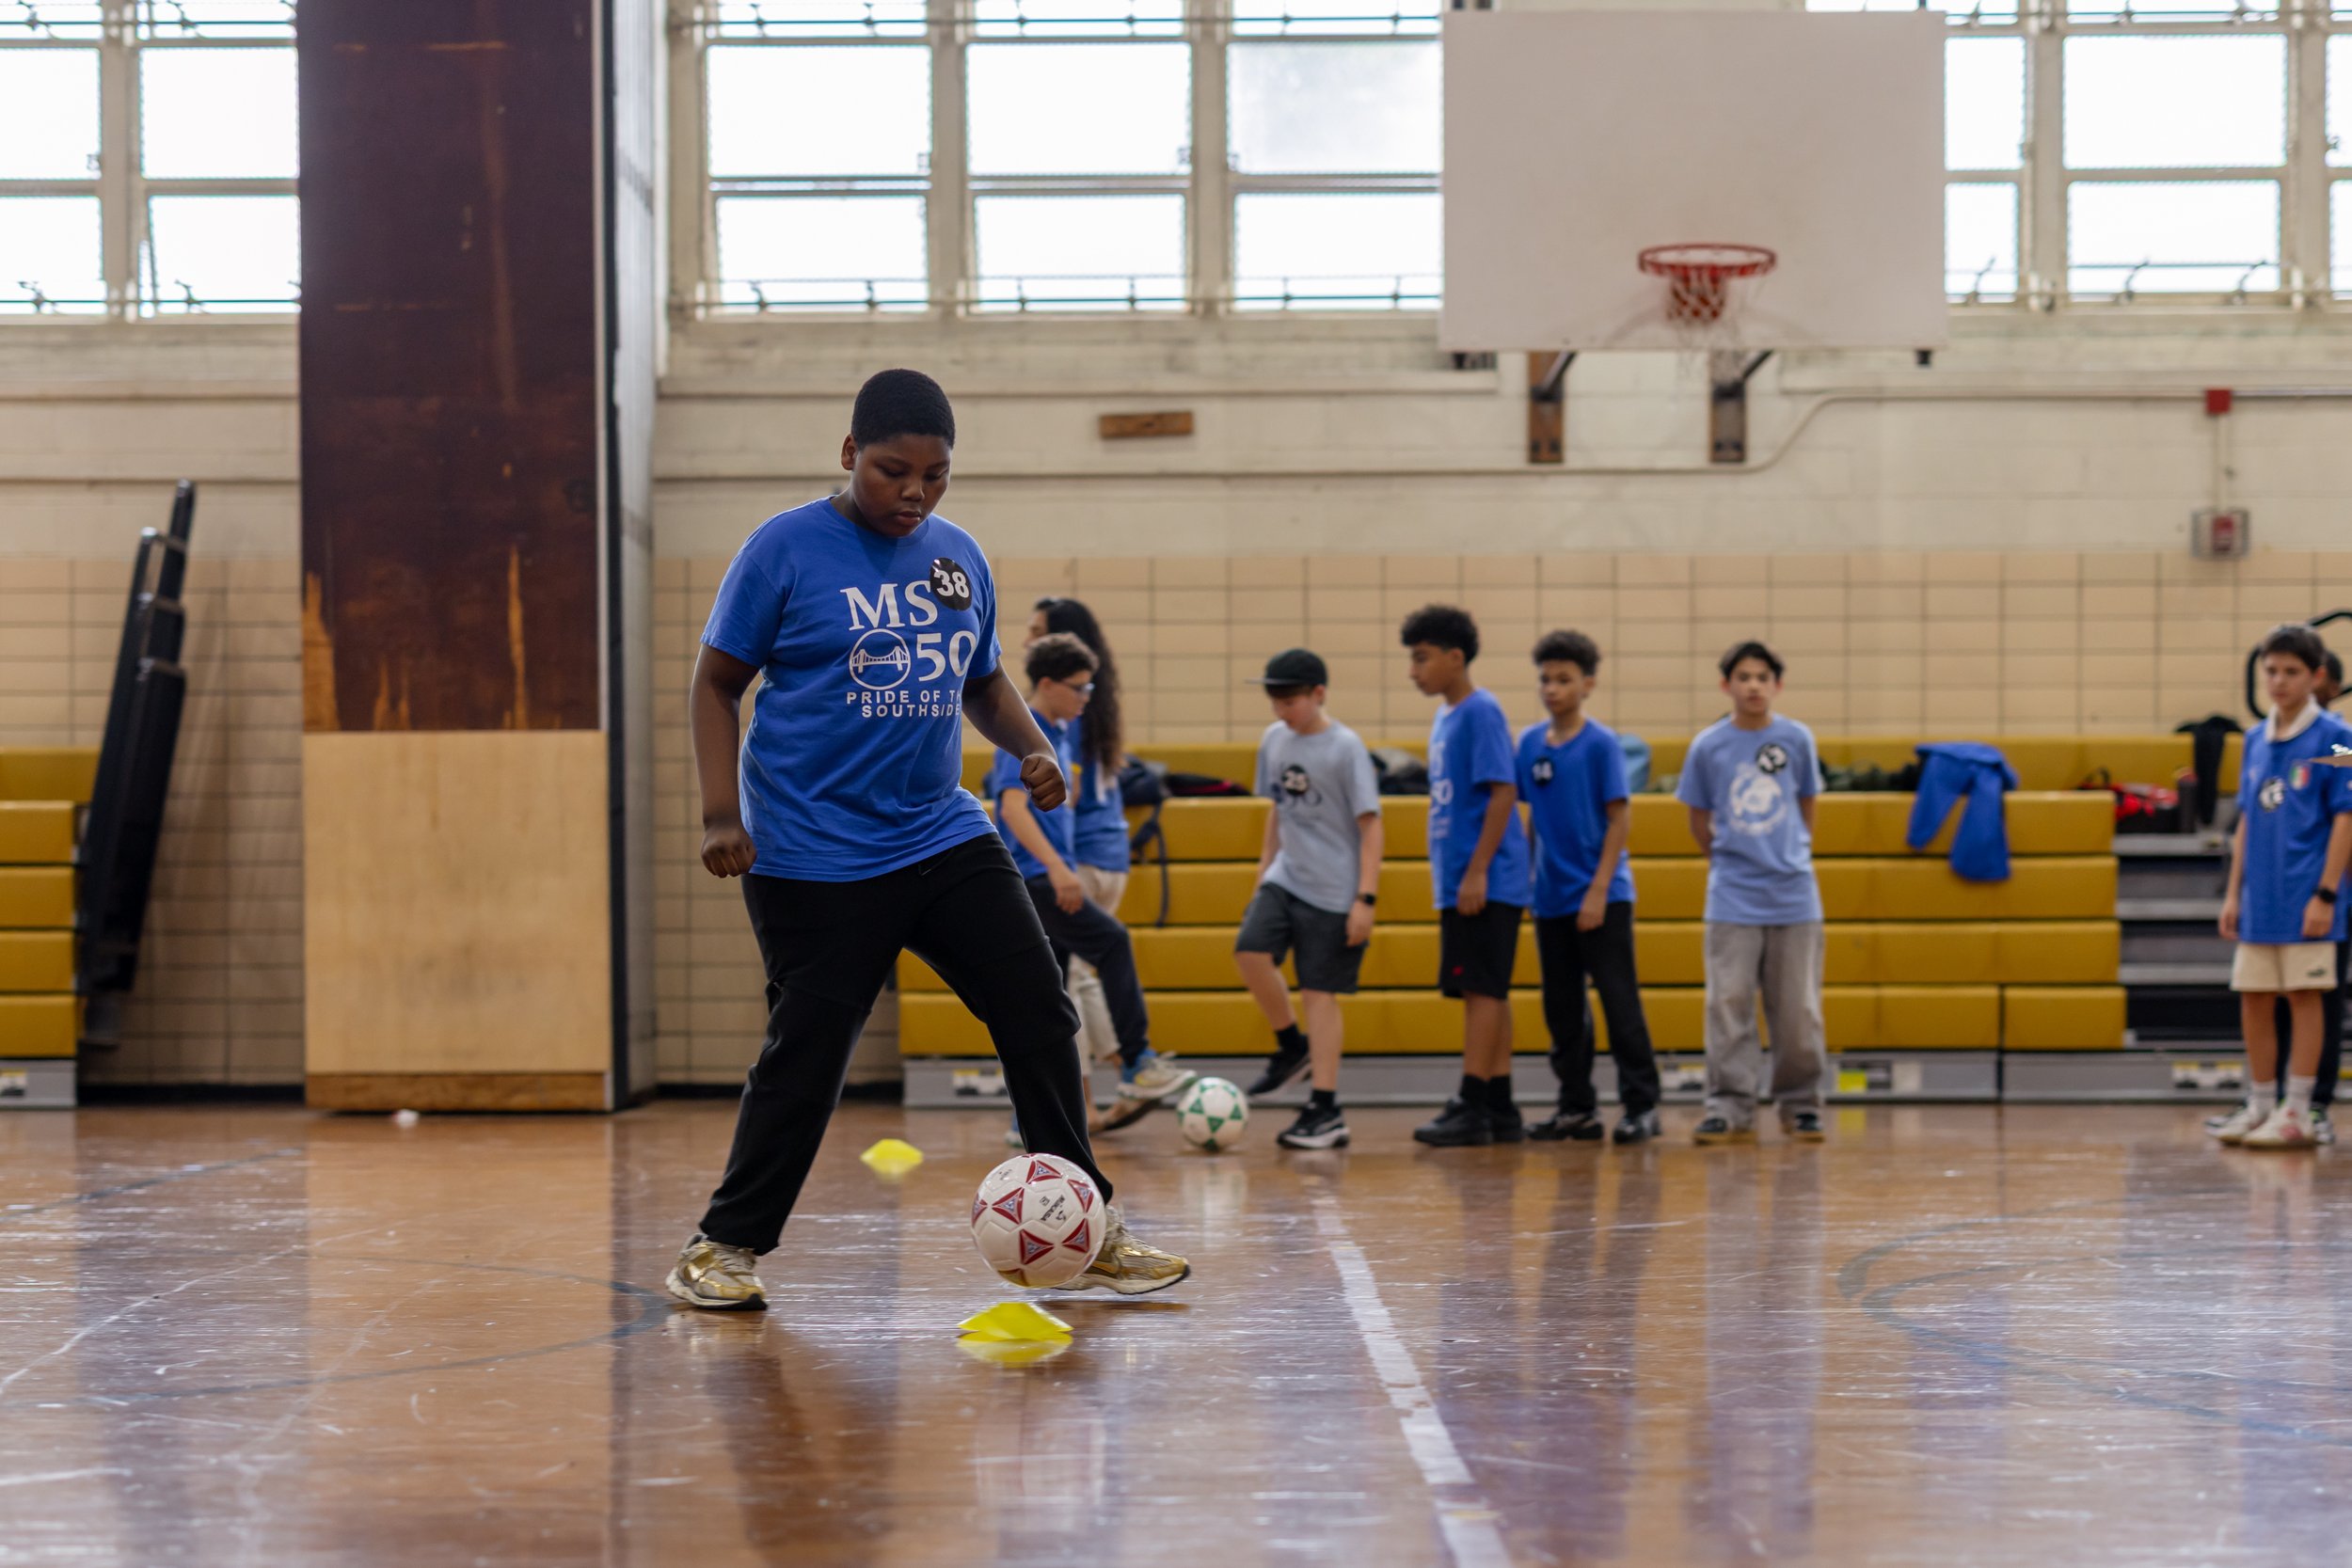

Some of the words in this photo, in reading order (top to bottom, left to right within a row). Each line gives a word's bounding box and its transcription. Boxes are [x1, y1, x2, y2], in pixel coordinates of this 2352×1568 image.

[933, 570, 970, 598] 38
[840, 579, 938, 631] MS
[916, 630, 977, 682] 50
[847, 689, 910, 705] PRIDE
[920, 689, 940, 704] OF
[949, 689, 961, 703] TH
[862, 704, 961, 718] SOUTHSIDE
